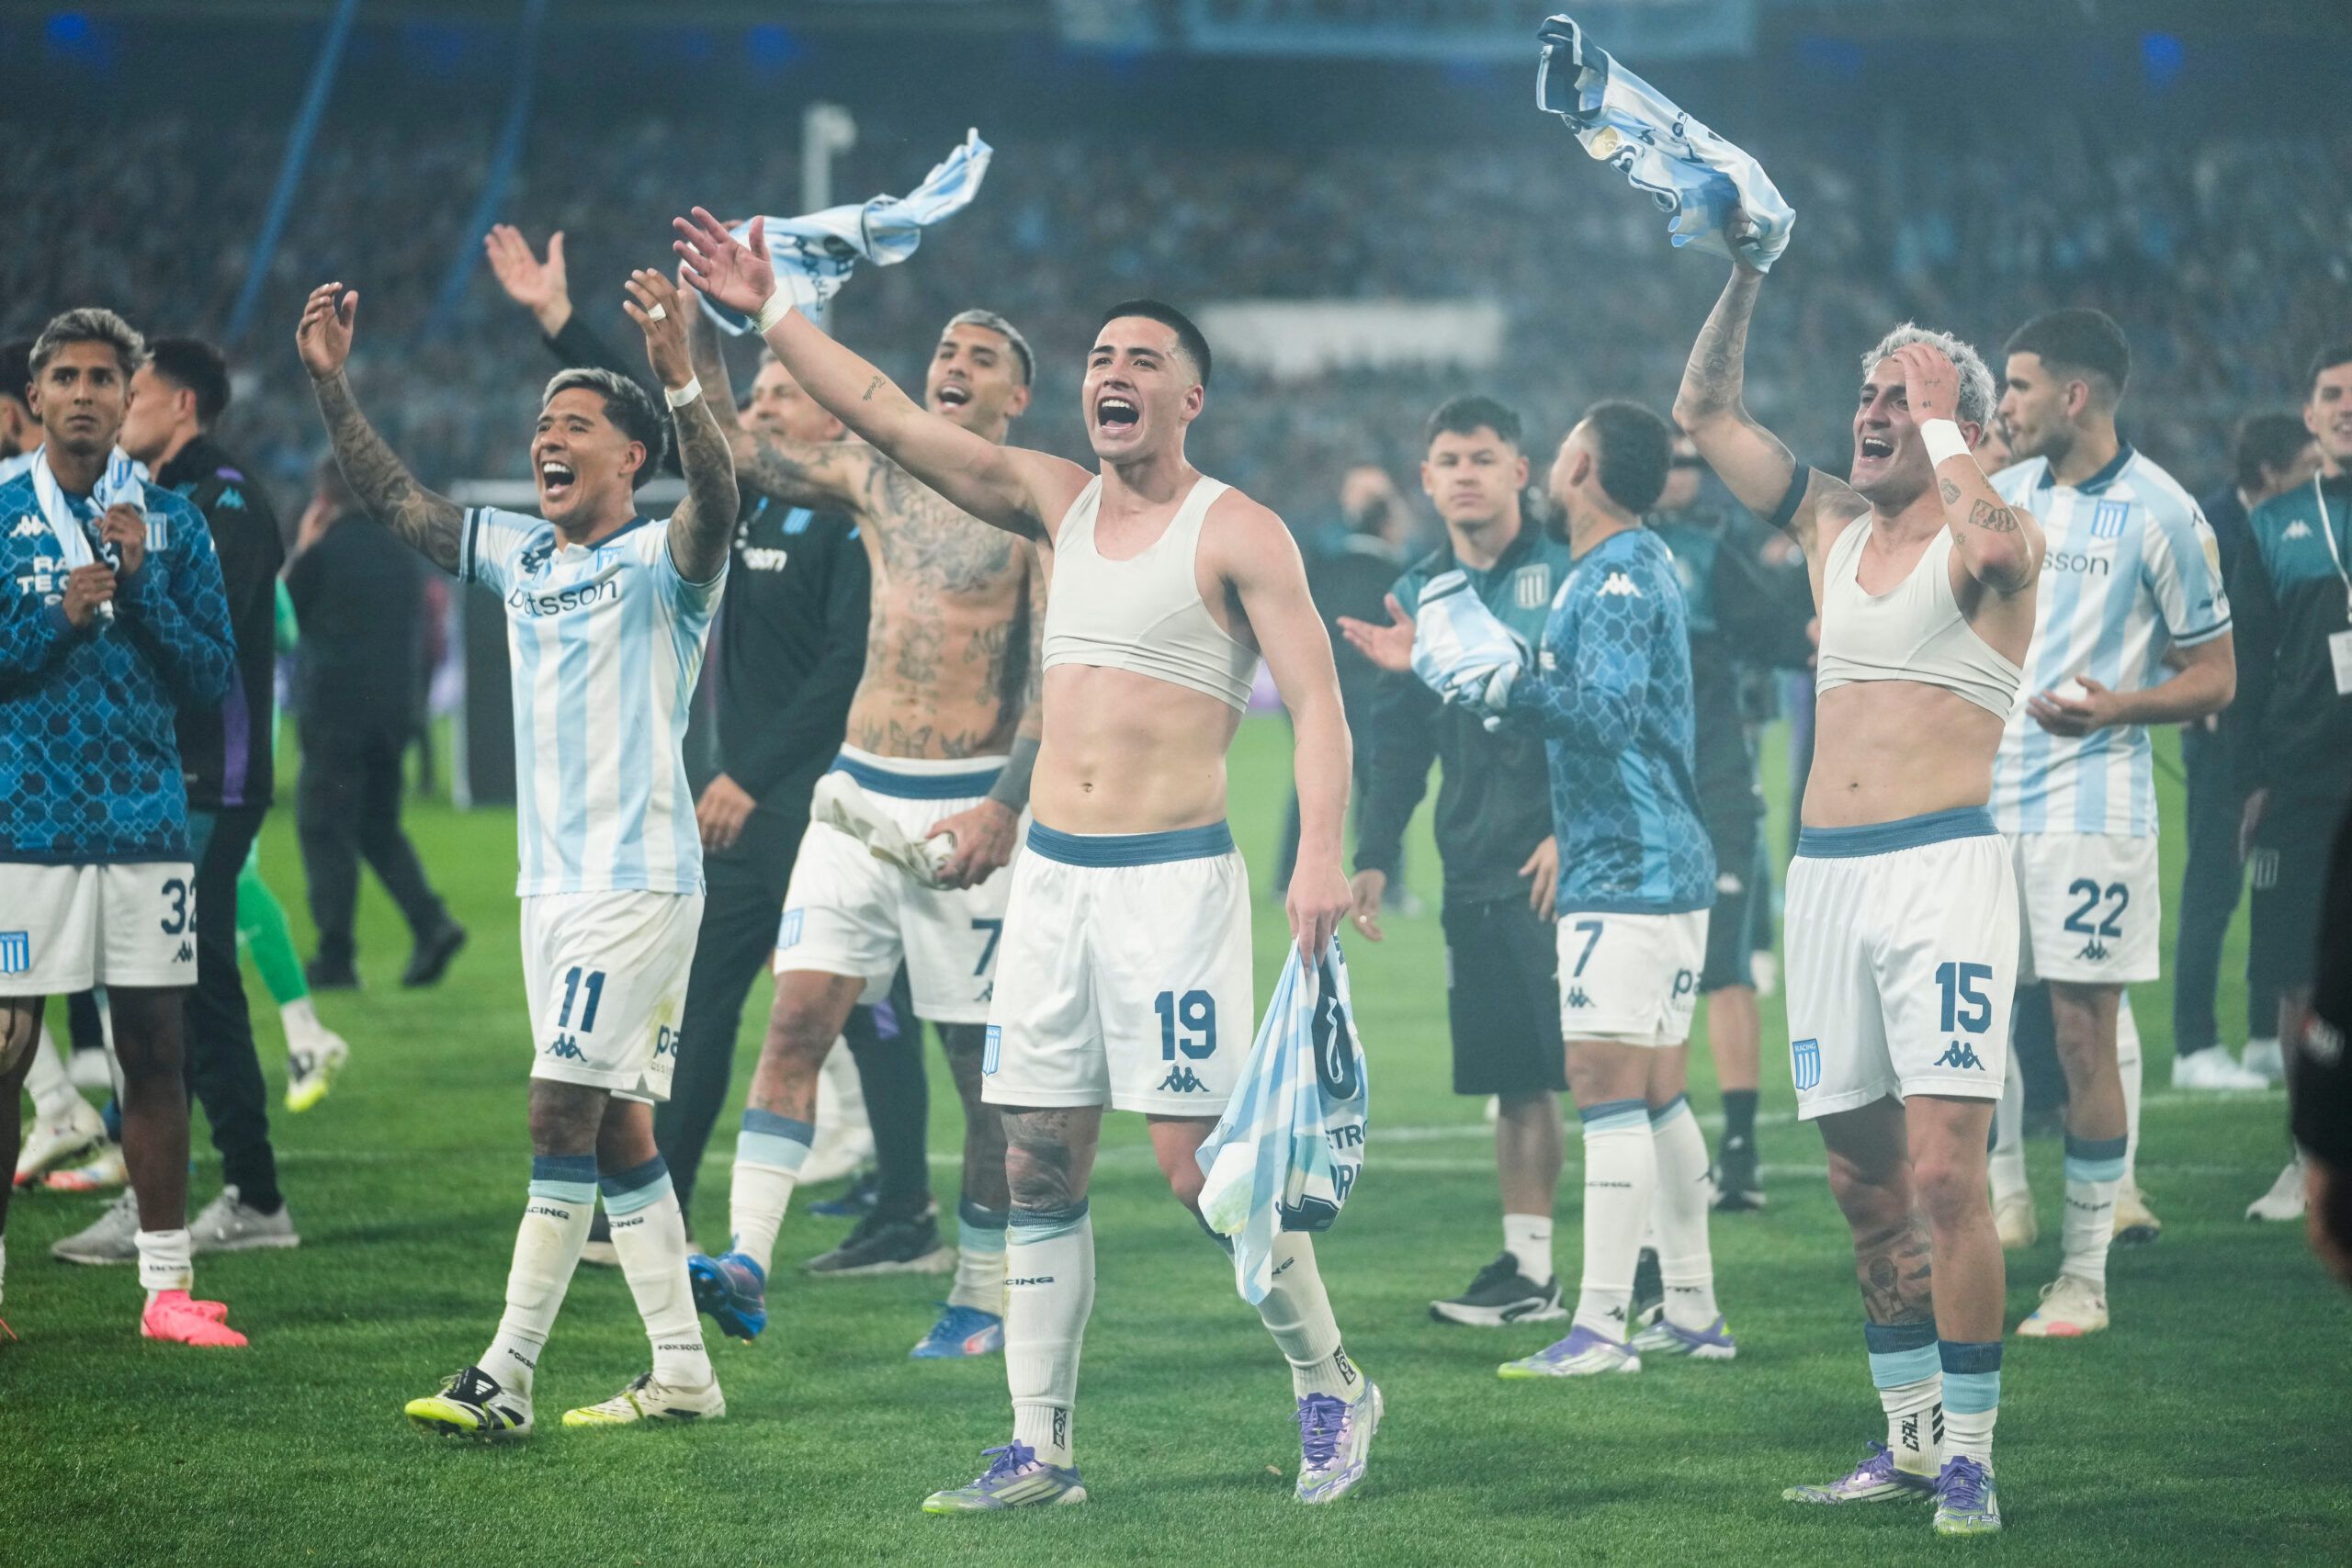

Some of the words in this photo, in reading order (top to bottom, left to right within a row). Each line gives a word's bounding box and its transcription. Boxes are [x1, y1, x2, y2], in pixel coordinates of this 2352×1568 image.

[17, 576, 52, 596] TE
[2064, 877, 2129, 937] 22
[971, 919, 1002, 976] 7
[1575, 920, 1603, 977] 7
[558, 966, 606, 1033] 11
[1154, 989, 1217, 1061] 19
[1935, 962, 1993, 1034] 15
[1055, 1408, 1067, 1450] FOX
[1902, 1413, 1919, 1452] CAL
